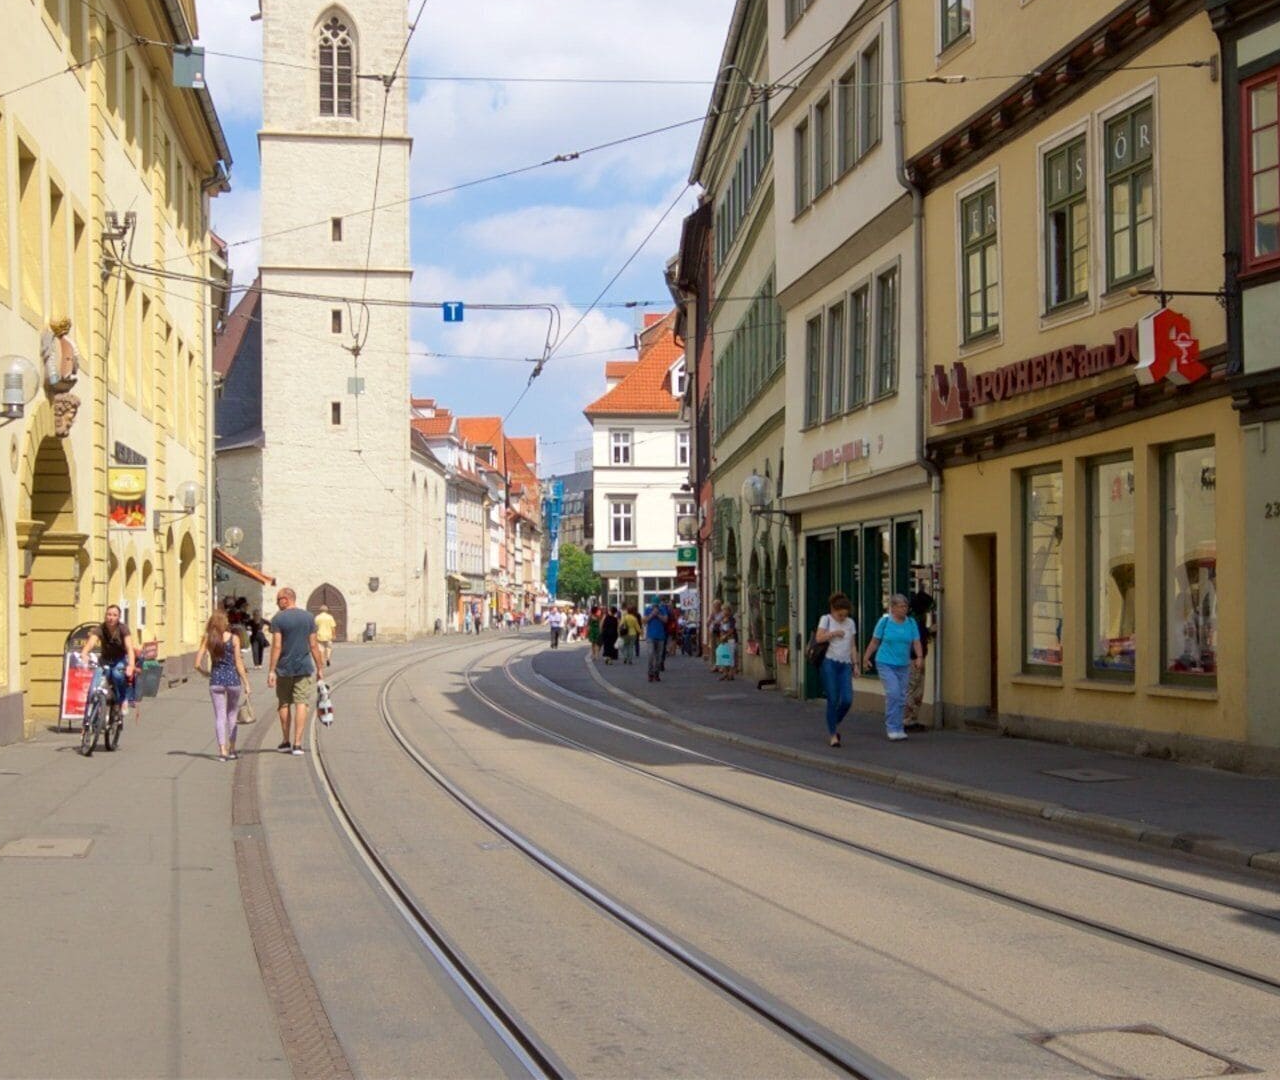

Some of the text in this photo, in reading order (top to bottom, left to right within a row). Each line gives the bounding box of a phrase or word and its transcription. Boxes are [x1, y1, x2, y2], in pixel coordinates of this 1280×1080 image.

[448, 303, 459, 321] T
[969, 345, 1082, 406] APOTHEKE
[1078, 344, 1113, 377] am
[1265, 502, 1280, 520] 23
